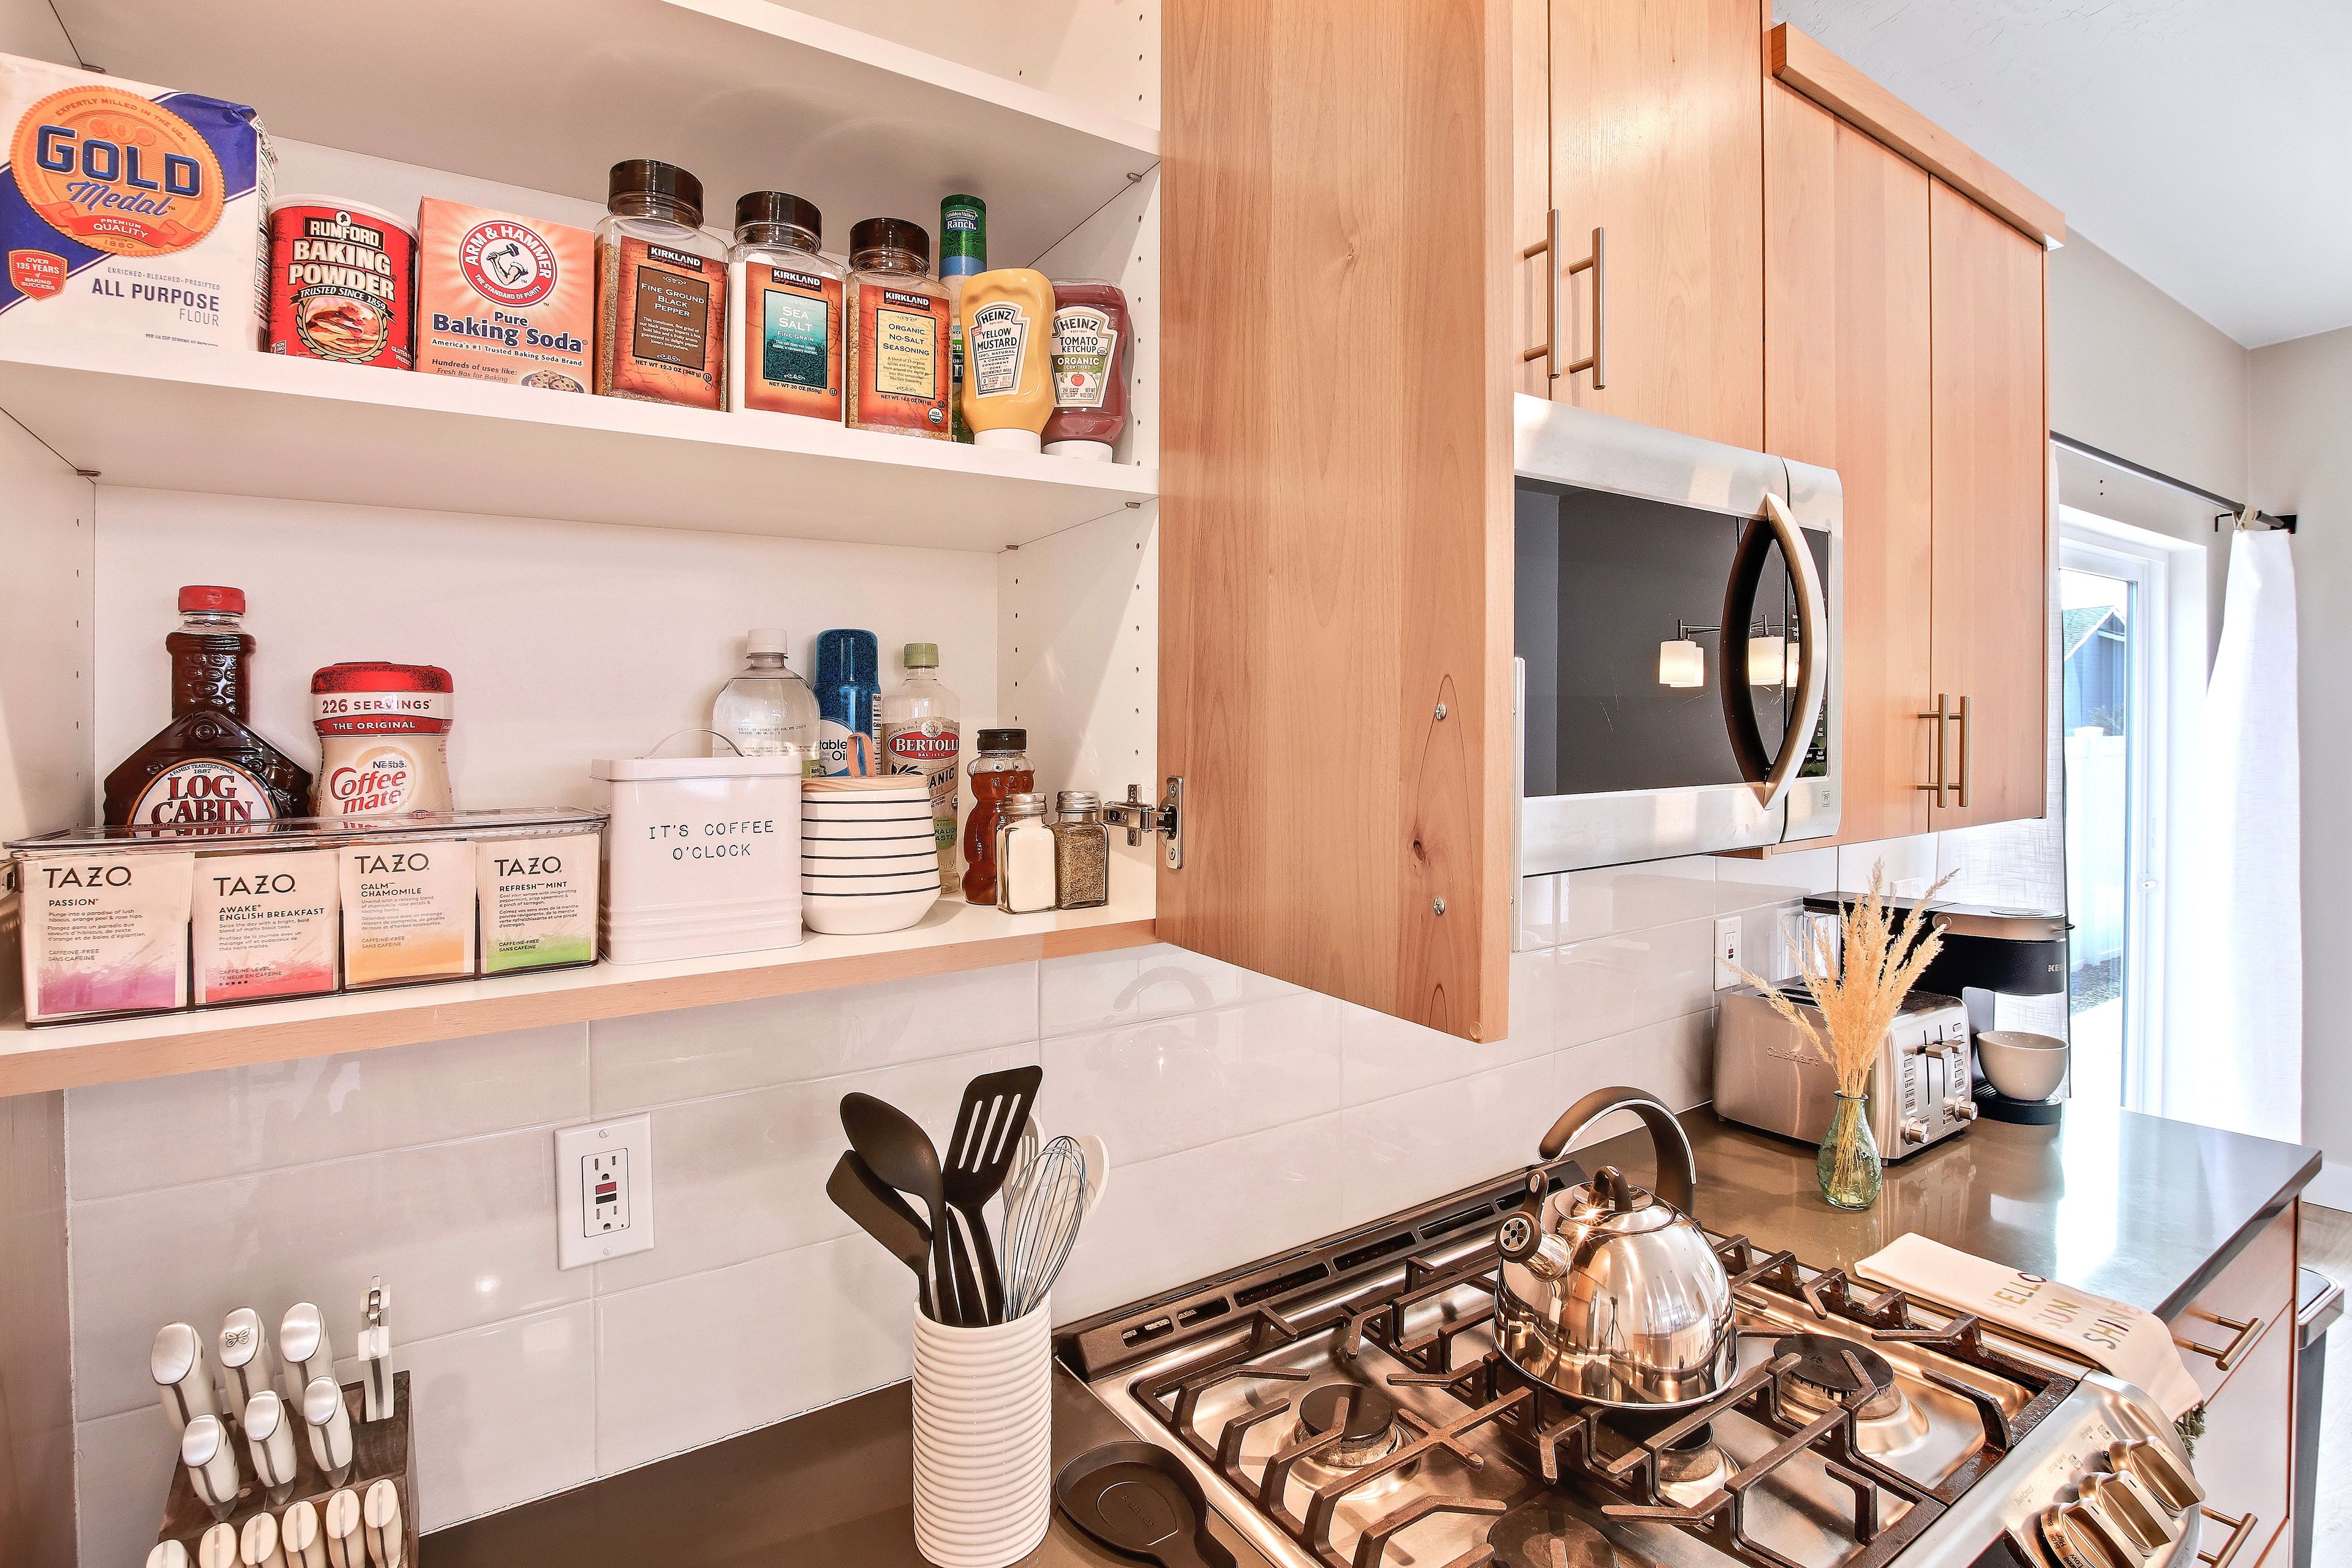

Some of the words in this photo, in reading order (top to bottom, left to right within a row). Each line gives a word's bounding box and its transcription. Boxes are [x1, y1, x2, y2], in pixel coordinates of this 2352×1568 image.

[55, 99, 97, 116] EXPERTLY
[102, 99, 137, 110] MILLED
[154, 115, 170, 127] THE
[172, 127, 187, 142] USA
[36, 124, 202, 198] GOLD
[66, 181, 174, 217] Medal
[94, 223, 149, 238] QUALITY
[100, 218, 141, 229] PREMIUM
[947, 220, 975, 230] Ranch
[310, 220, 379, 244] RUMFORD
[104, 239, 134, 249] 1880
[465, 232, 487, 266] ARM
[485, 227, 499, 240] &
[500, 225, 552, 279] HAMMER
[293, 240, 391, 276] BAKING
[650, 247, 701, 266] KIRKLAND
[32, 264, 59, 274] YEARS
[288, 263, 396, 302] POWDER
[774, 270, 821, 285] KIRKLAND
[21, 282, 55, 290] SUCCESS
[474, 274, 486, 288] THE
[484, 284, 515, 300] STANDARD
[524, 285, 542, 298] PURITY
[641, 282, 666, 293] FINE
[666, 288, 705, 304] GROUND
[92, 279, 124, 298] ALL
[132, 283, 219, 312] PURPOSE
[301, 287, 336, 298] TRUSTED
[338, 288, 364, 301] SINCE
[367, 296, 386, 310] 1859
[658, 295, 688, 309] BLACK
[885, 292, 929, 306] KIRKLAND
[179, 308, 219, 326] FLOUR
[655, 303, 690, 317] PEPPER
[782, 306, 809, 320] SEA
[981, 311, 1011, 324] HEINZ
[494, 311, 528, 326] Pure
[778, 317, 813, 333] SALT
[1060, 318, 1098, 331] HEINZ
[433, 314, 519, 347] Baking
[526, 328, 582, 353] Soda
[888, 324, 925, 335] ORGANIC
[981, 328, 1011, 339] YELLOW
[889, 334, 924, 345] NO-SALT
[978, 337, 1017, 351] MUSTARD
[1060, 337, 1098, 346] TOMATO
[432, 339, 470, 349] America's
[484, 346, 511, 355] Trusted
[514, 350, 539, 360] Baking
[883, 343, 930, 356] SEASONING
[432, 359, 469, 369] Hundreds
[501, 367, 518, 375] like:
[1057, 357, 1100, 366] ORGANIC
[484, 374, 508, 383] Baking
[322, 699, 348, 714] 226
[353, 700, 429, 710] SERINGS
[357, 721, 416, 729] ORIGINAL
[895, 738, 958, 752] BERTOLLI
[173, 766, 191, 777] FAMILY
[219, 766, 234, 775] SINCE
[167, 775, 237, 801] LOG
[330, 767, 406, 801] Coffee
[343, 788, 401, 815] mate
[151, 799, 254, 825] CABIN
[649, 824, 688, 839] IT'S
[704, 820, 773, 835] COFFEE
[673, 843, 750, 860] O'CLOCK
[355, 853, 428, 873] TAZO
[494, 856, 562, 876] TAZO
[43, 866, 131, 888] TAZO
[213, 874, 295, 896] TAZO
[361, 888, 421, 897] CHAMOMILE
[219, 905, 257, 914] AWAKE
[220, 913, 264, 921] ENGLISH
[267, 908, 325, 919] BREAKFAST
[1767, 1046, 1819, 1066] Cuisinart
[1984, 1272, 2047, 1312] HELLO
[2032, 1298, 2082, 1330] SUN
[2082, 1301, 2143, 1350] SHINE
